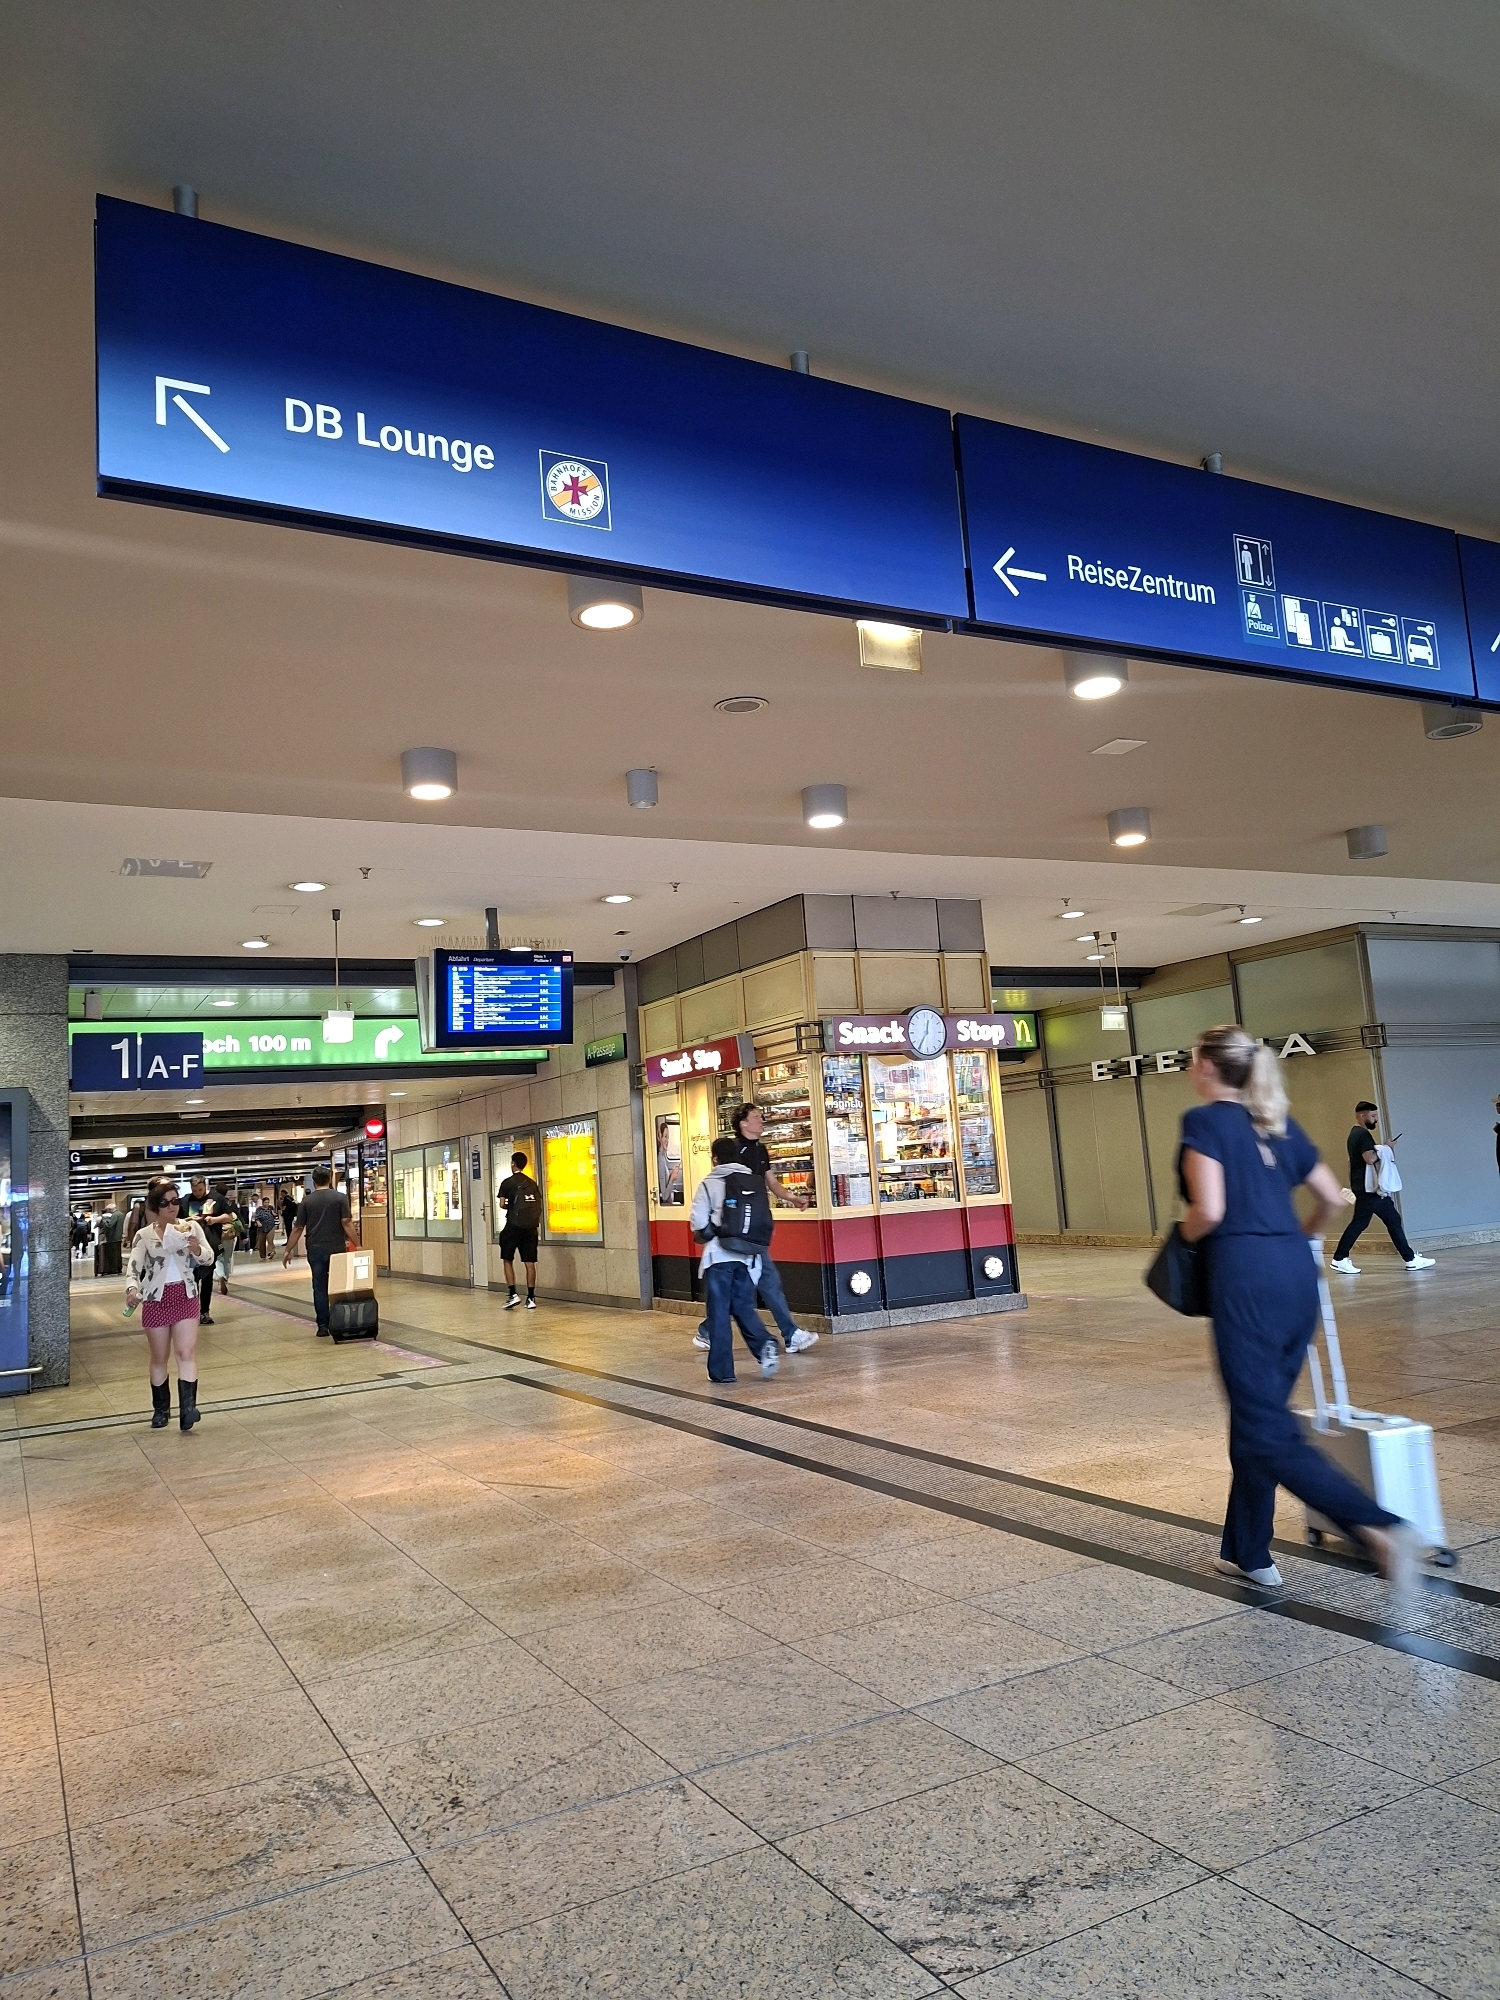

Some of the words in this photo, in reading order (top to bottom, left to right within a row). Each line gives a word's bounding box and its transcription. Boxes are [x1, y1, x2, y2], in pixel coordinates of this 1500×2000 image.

[285, 397, 342, 440] DB
[357, 412, 495, 473] Lounge
[551, 464, 587, 492] BAHNHOFS
[569, 494, 600, 516] MISSION
[1067, 554, 1216, 605] ReiseZentrum
[1248, 619, 1274, 633] Polizei
[202, 1034, 240, 1053] och
[248, 1034, 287, 1052] 100
[291, 1036, 311, 1052] m
[838, 1020, 907, 1045] Snack
[956, 1020, 1005, 1045] Stop
[111, 1037, 129, 1079] 1
[587, 1043, 616, 1060] A-Passage
[1091, 1033, 1317, 1081] ETEA
[147, 1054, 200, 1079] A-F
[70, 1152, 81, 1163] G
